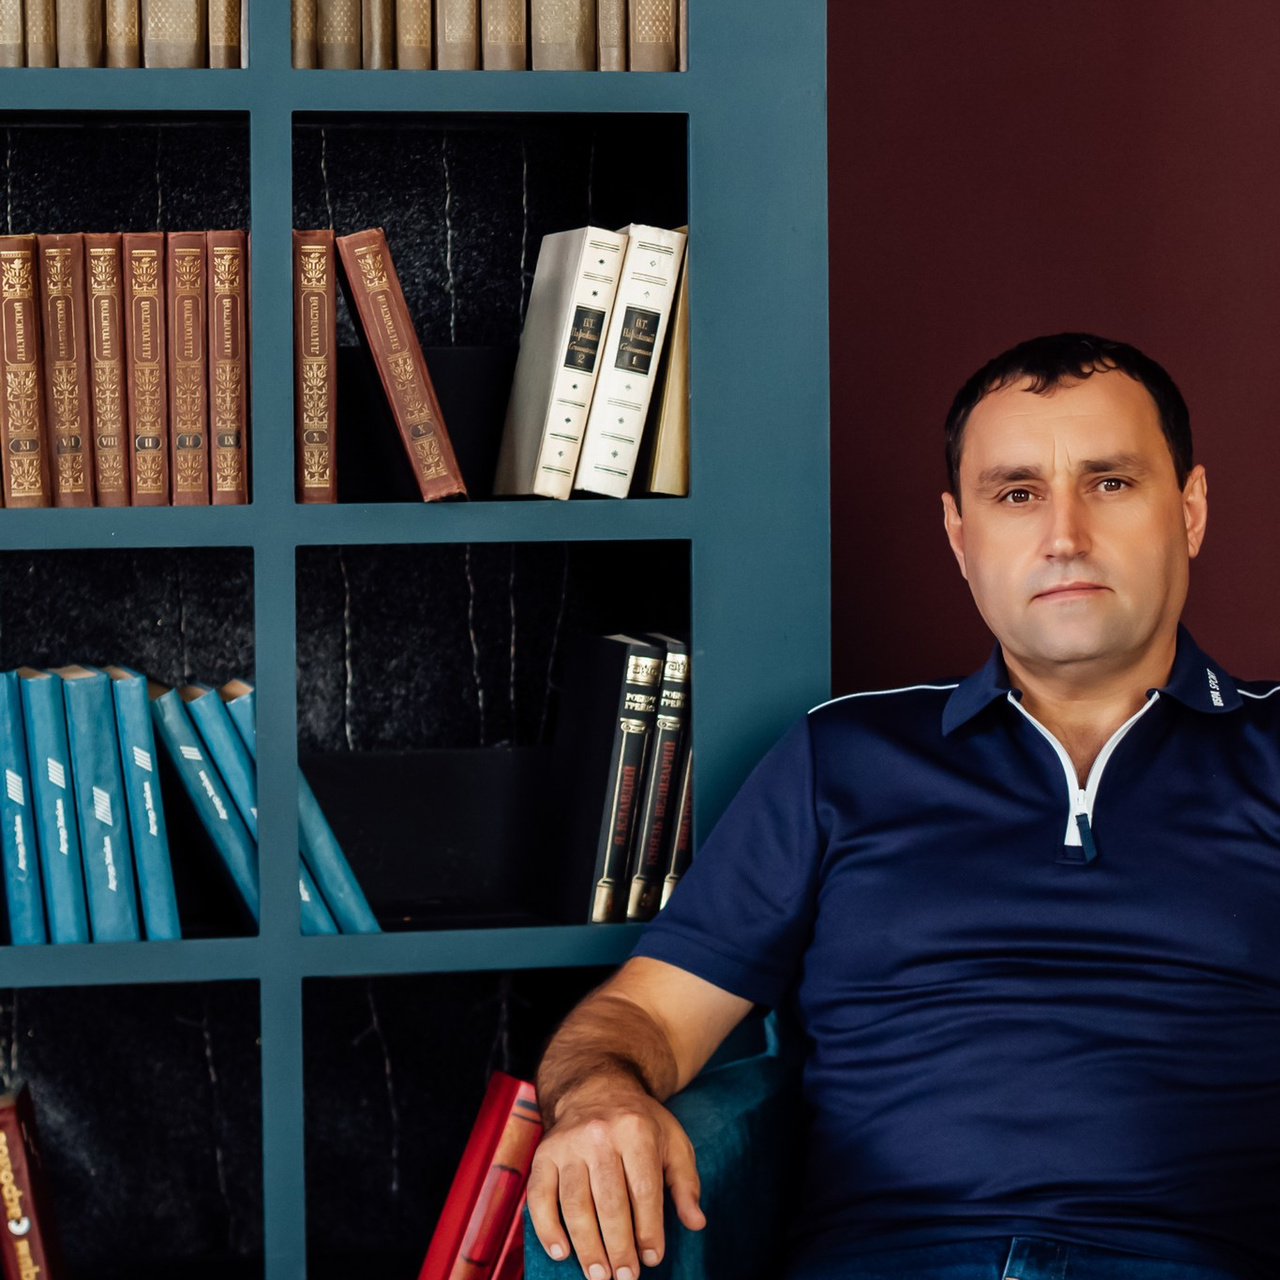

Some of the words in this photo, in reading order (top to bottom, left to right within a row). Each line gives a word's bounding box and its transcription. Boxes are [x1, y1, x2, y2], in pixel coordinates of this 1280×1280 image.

[577, 354, 586, 364] 2
[631, 355, 638, 365] 1
[102, 437, 118, 447] VIII
[224, 435, 234, 446] IX
[313, 432, 320, 442] X
[19, 441, 31, 451] XI
[144, 438, 152, 448] II
